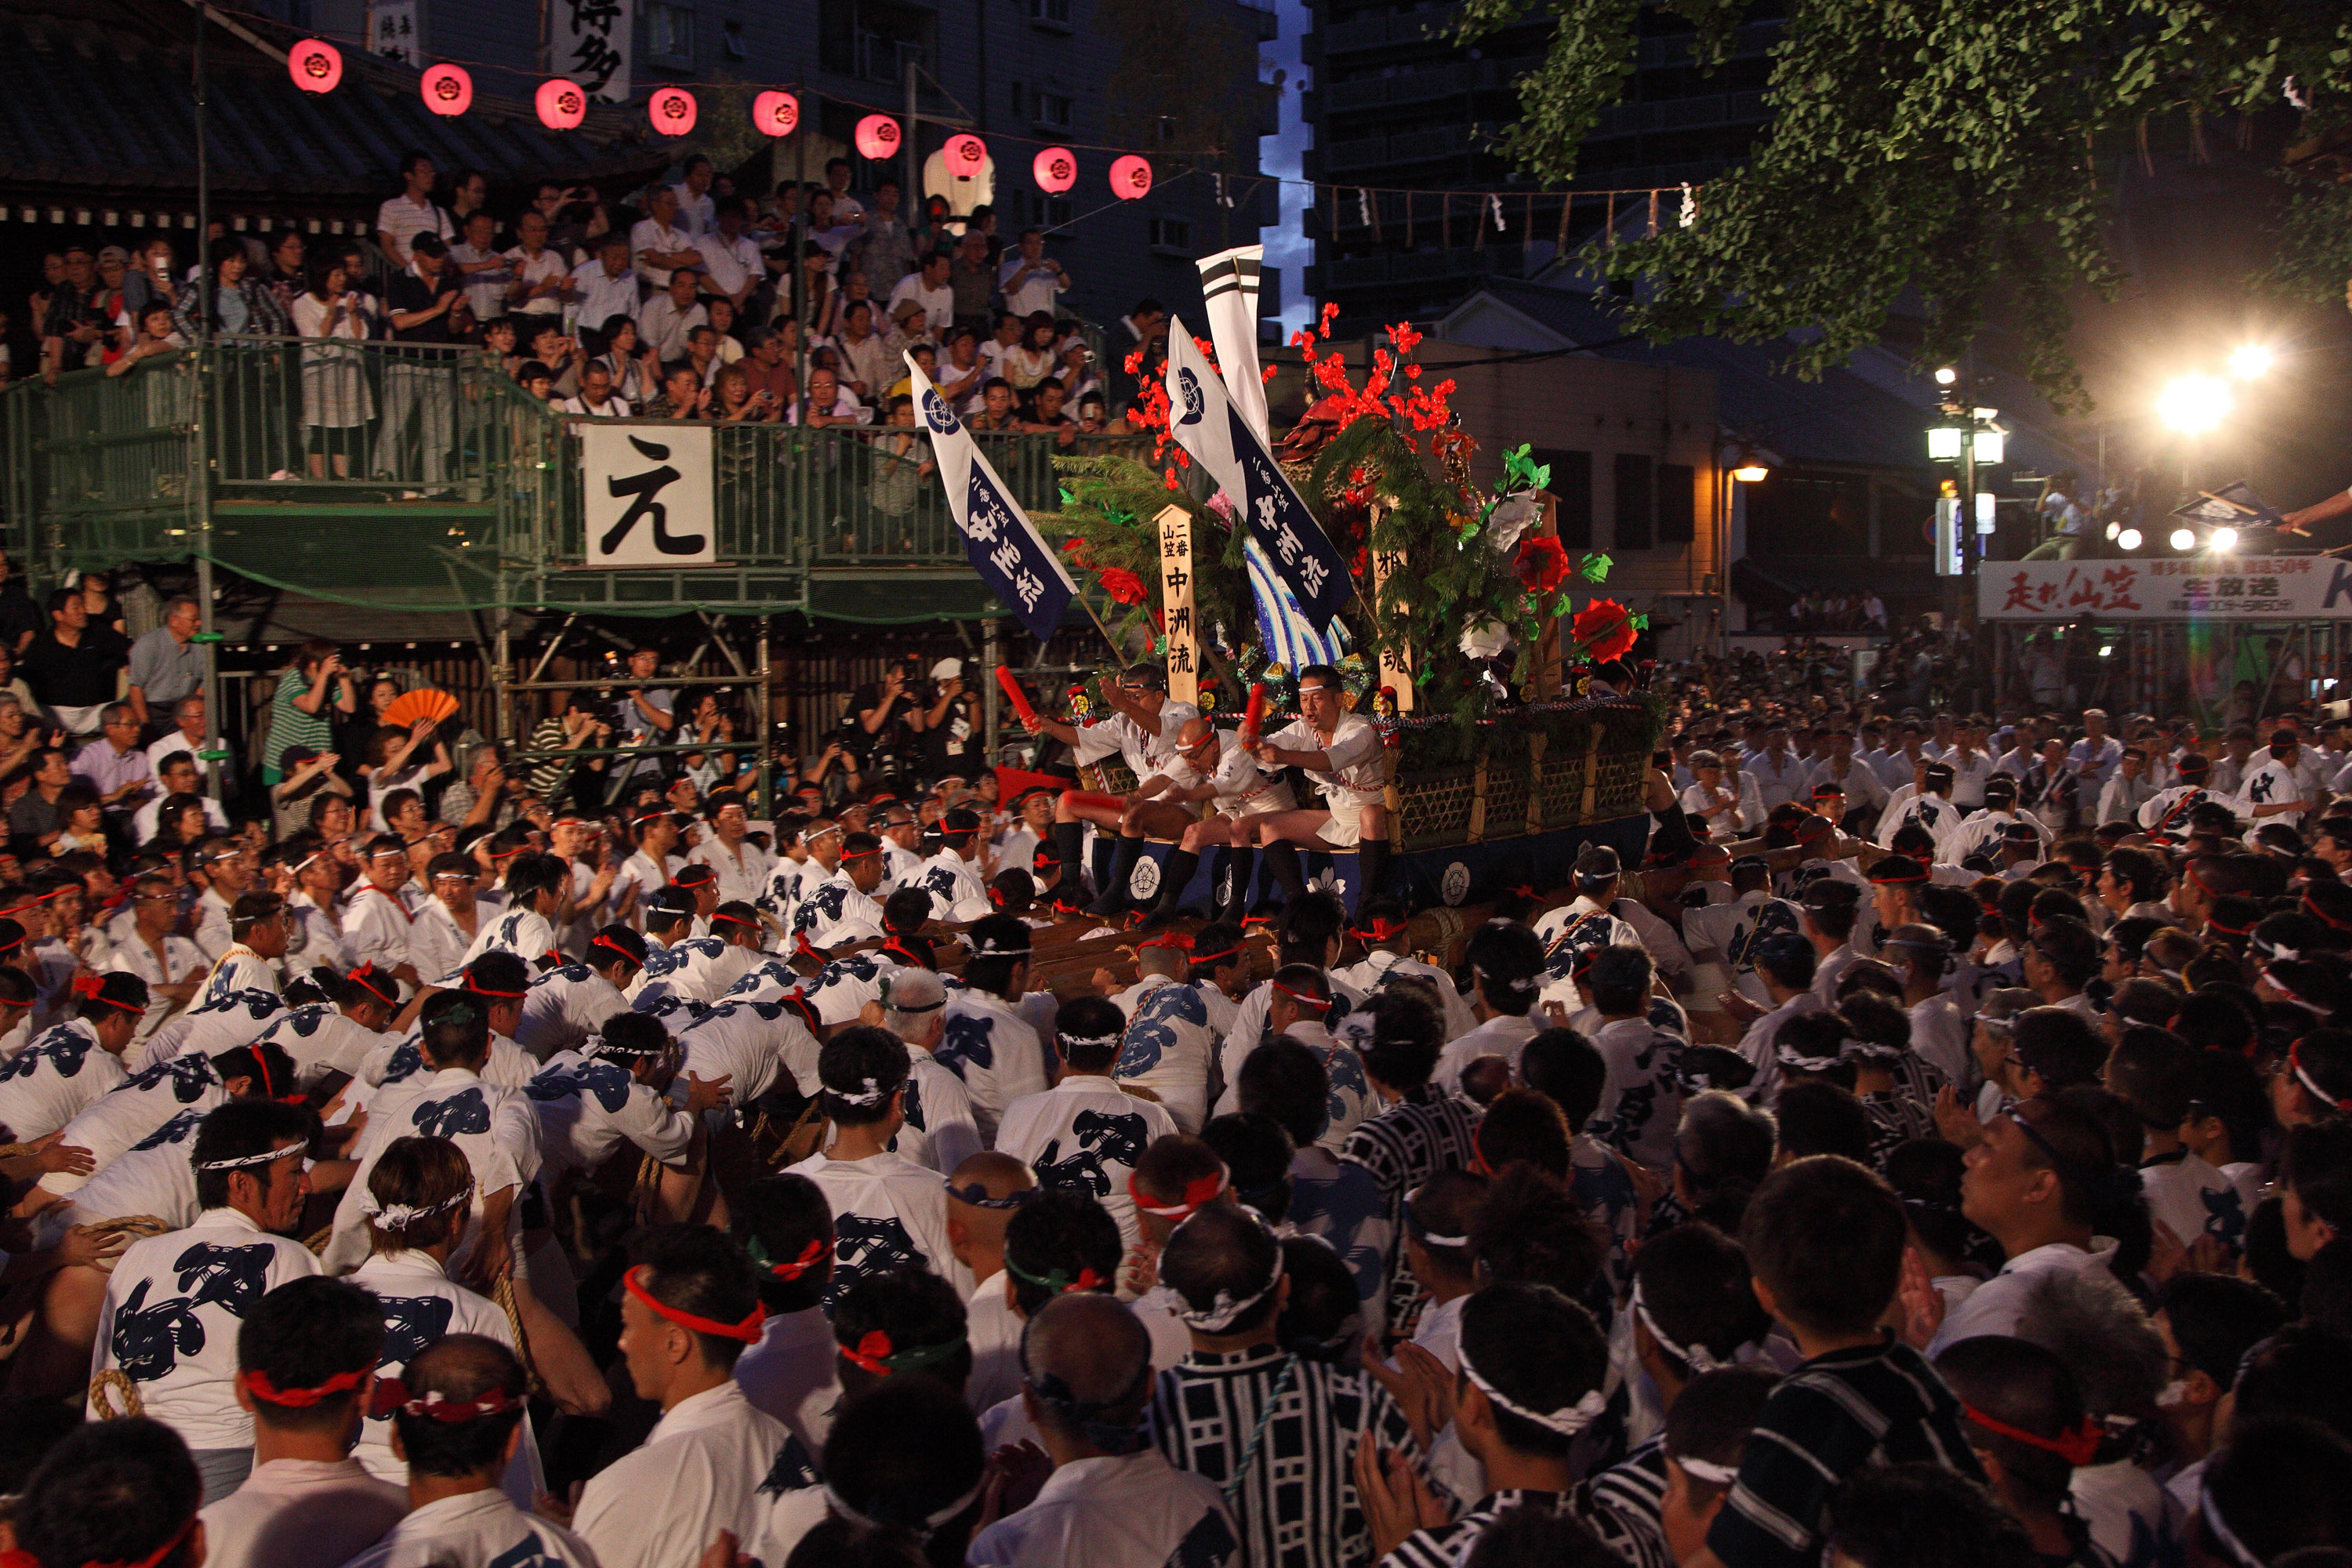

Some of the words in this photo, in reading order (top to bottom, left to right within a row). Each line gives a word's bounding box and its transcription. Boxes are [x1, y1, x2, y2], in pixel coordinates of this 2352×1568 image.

[566, 0, 622, 103] 博多
[601, 434, 705, 555] え
[1253, 456, 1289, 513] 二番山笠
[1163, 524, 1175, 558] 山笠
[1176, 524, 1189, 557] 二番
[1255, 495, 1330, 599] 中洲流
[1166, 566, 1194, 673] 中洲流
